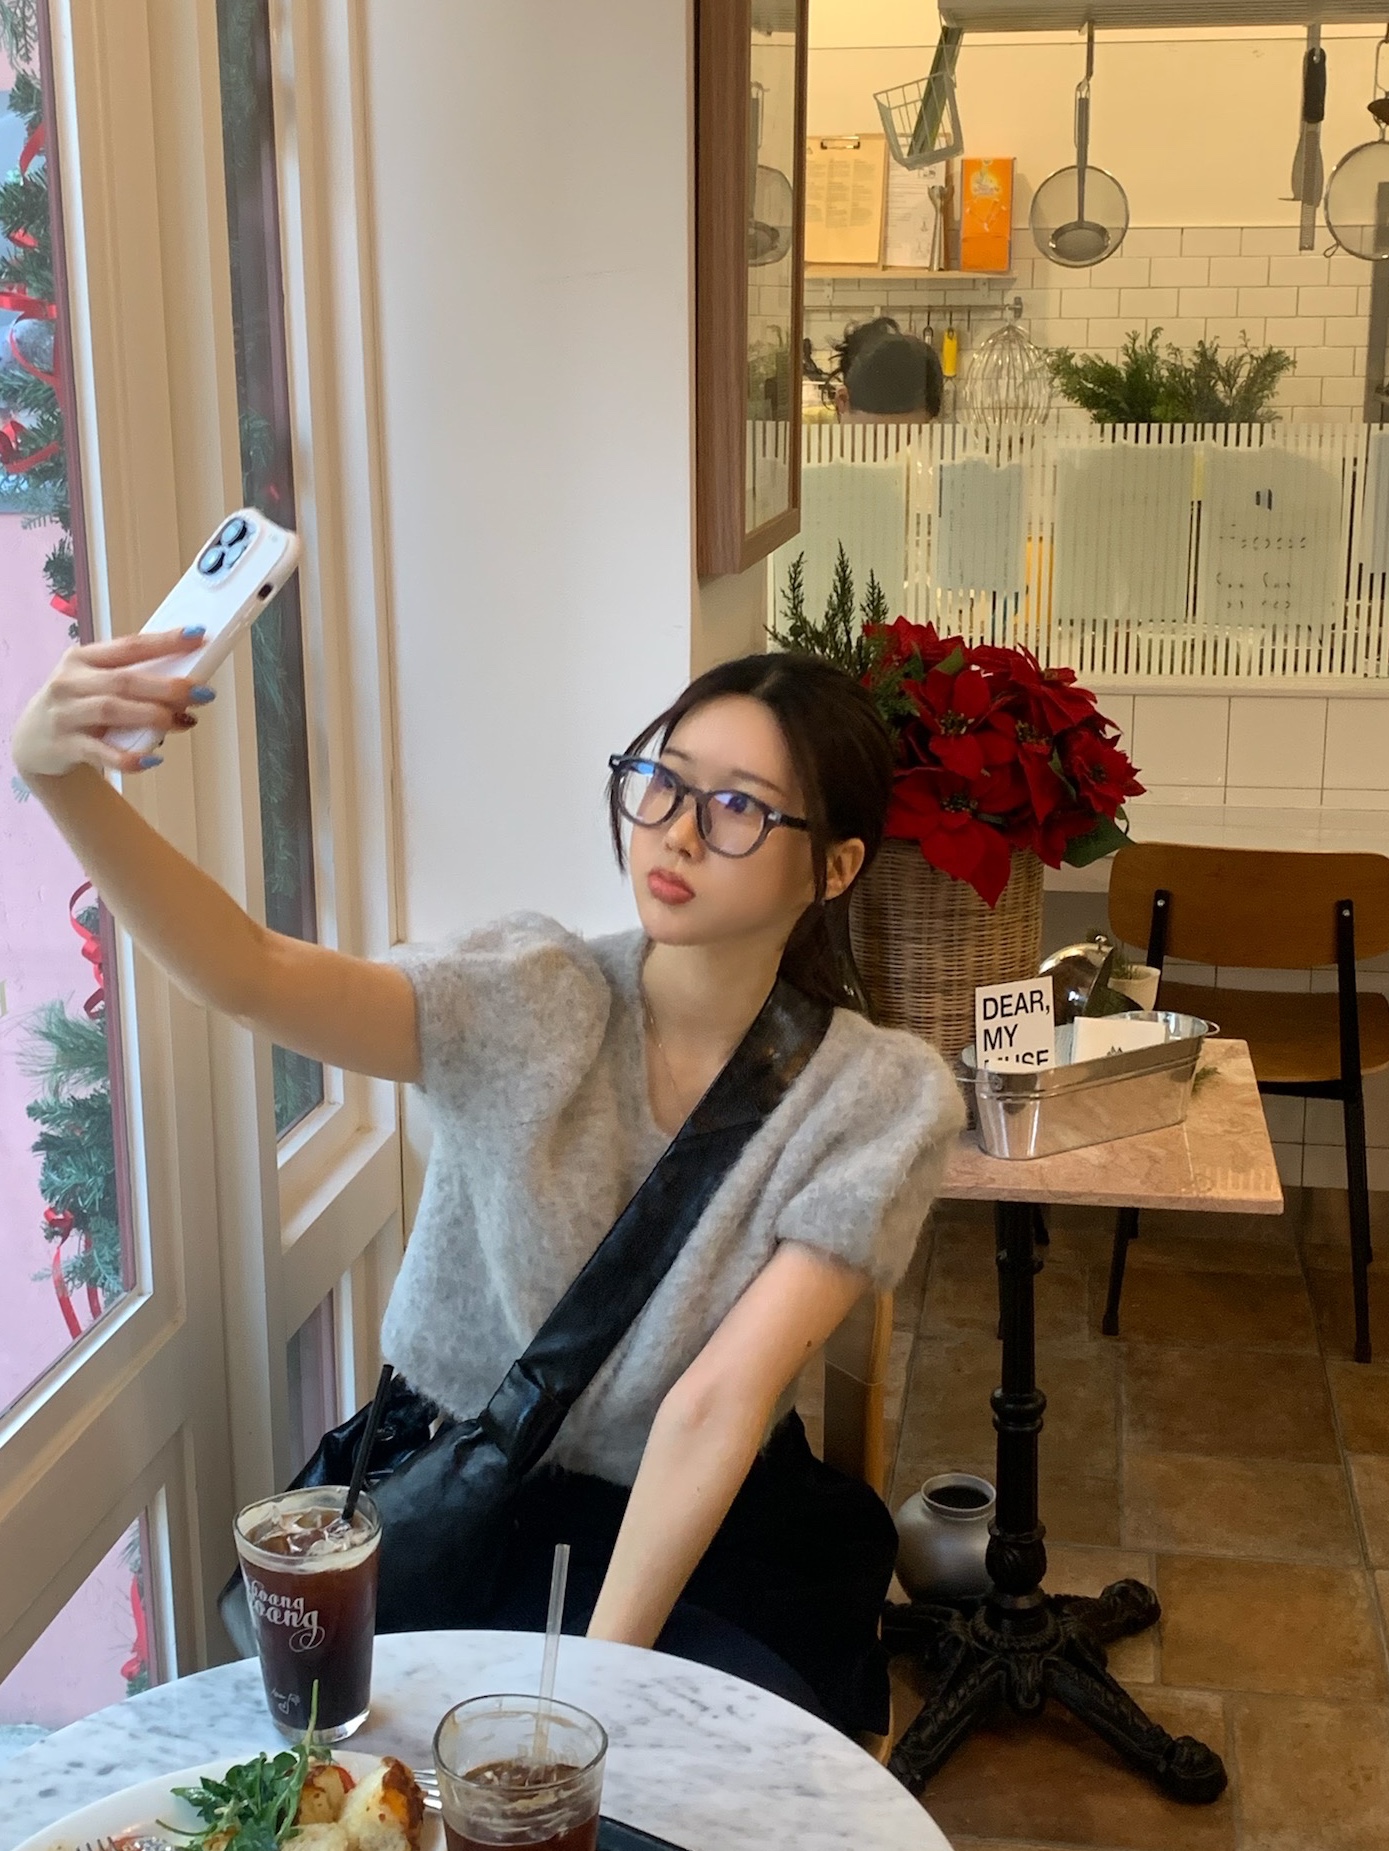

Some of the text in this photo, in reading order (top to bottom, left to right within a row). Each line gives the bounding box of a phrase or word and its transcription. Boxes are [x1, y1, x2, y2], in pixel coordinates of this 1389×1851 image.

[983, 989, 1050, 1021] DEAR,
[984, 1023, 1018, 1052] MY
[984, 1049, 1049, 1068] SE
